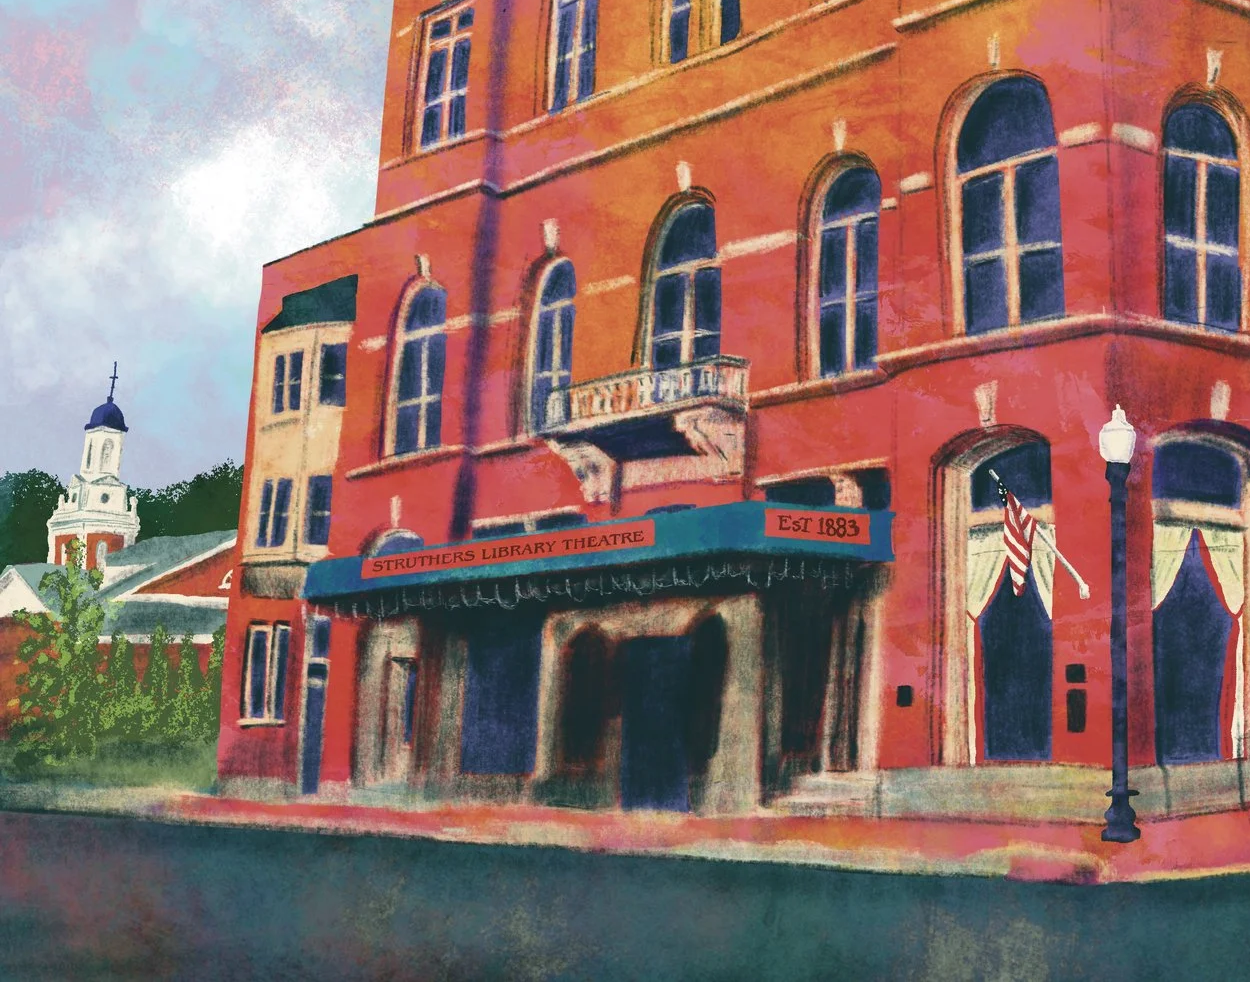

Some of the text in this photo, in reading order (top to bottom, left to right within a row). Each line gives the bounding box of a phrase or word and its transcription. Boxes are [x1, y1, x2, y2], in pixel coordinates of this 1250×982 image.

[817, 517, 860, 538] 1883
[372, 530, 645, 572] STRUTHERS LIBRARY THEATRE
